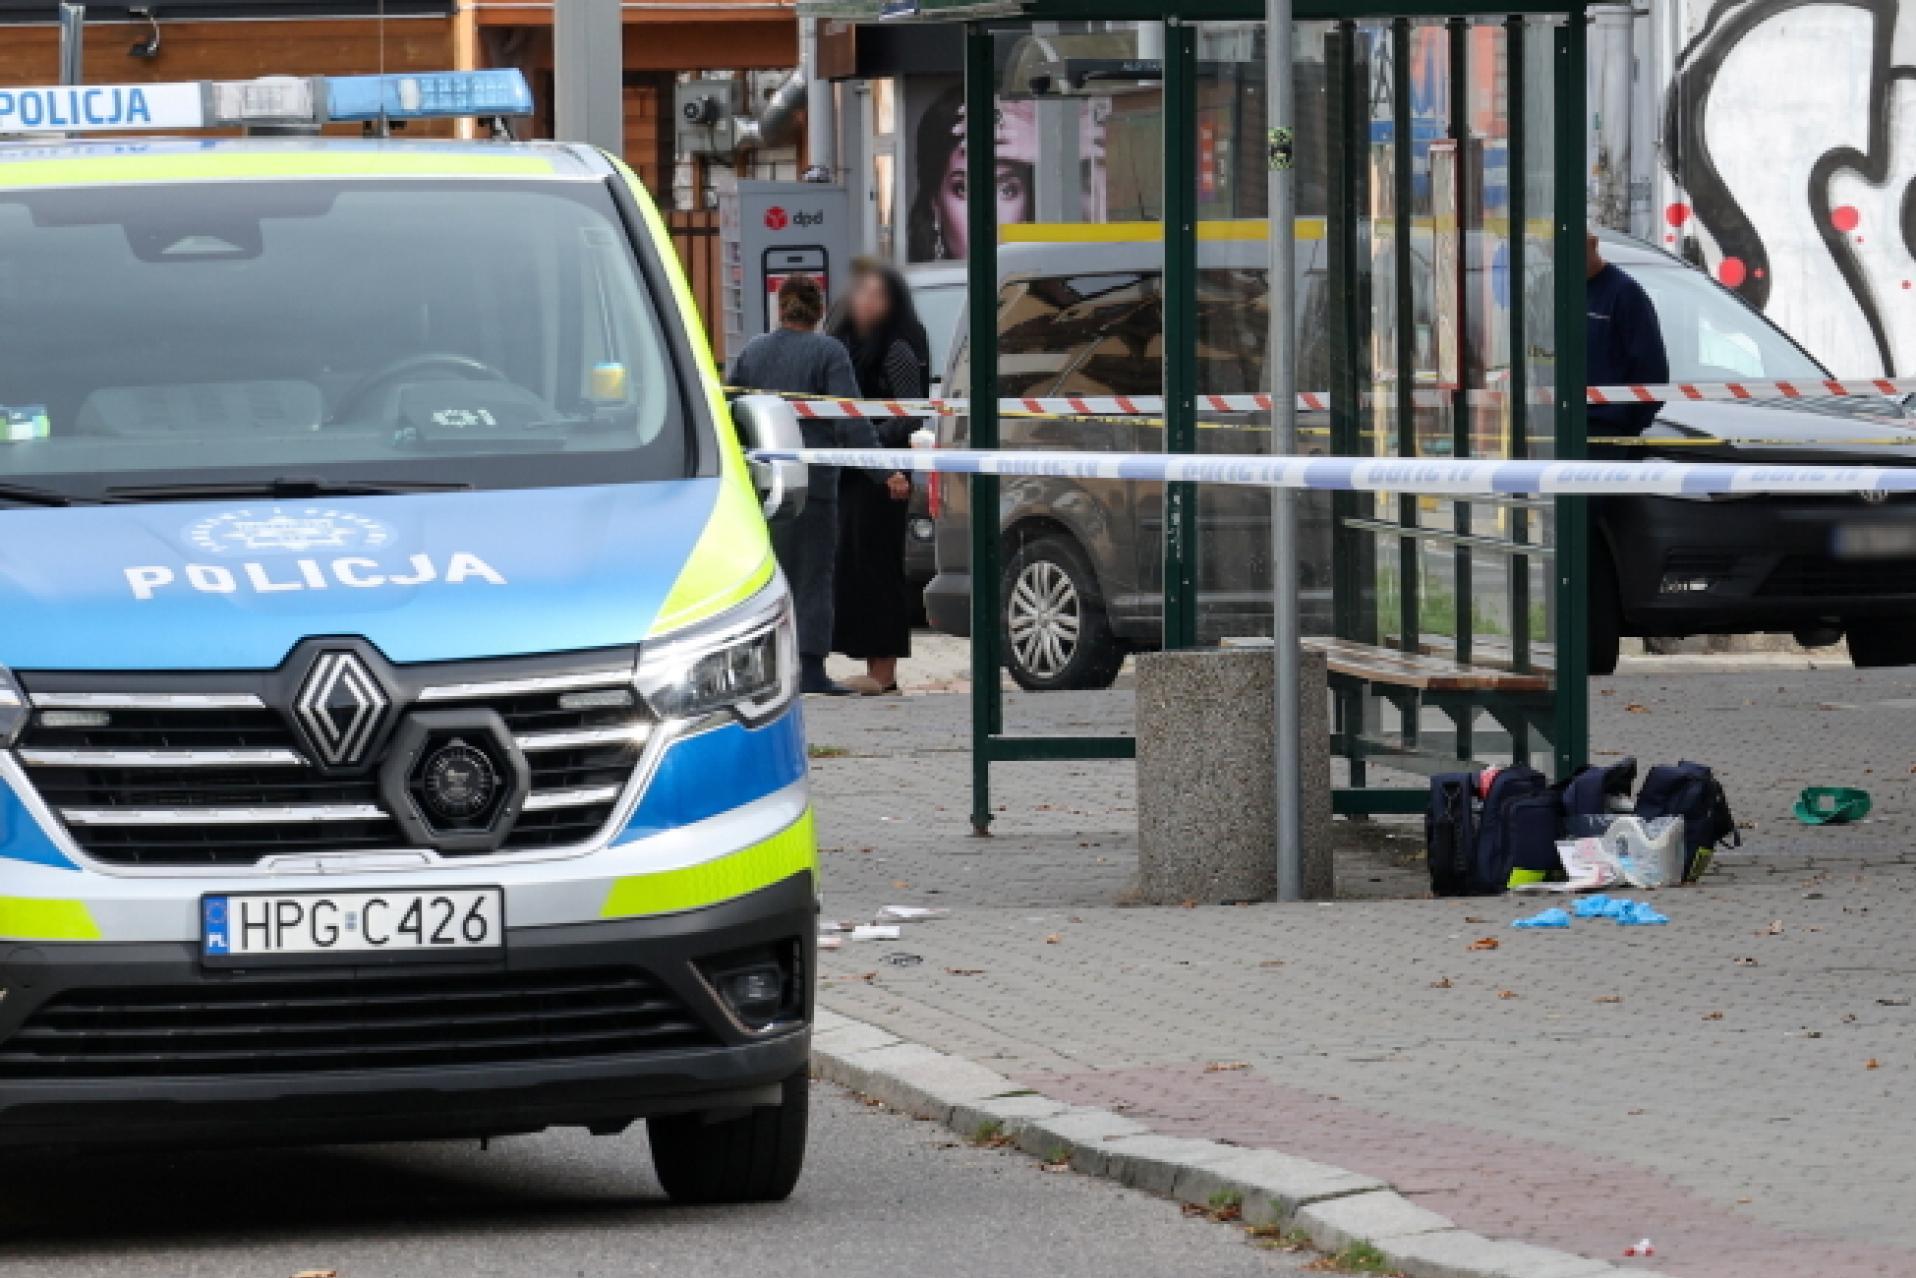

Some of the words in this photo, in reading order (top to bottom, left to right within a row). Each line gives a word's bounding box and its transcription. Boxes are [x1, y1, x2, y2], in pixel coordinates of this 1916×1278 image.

[793, 209, 824, 228] dpd
[123, 552, 508, 600] POLICJA
[241, 899, 340, 950] HPG
[362, 896, 488, 946] C426
